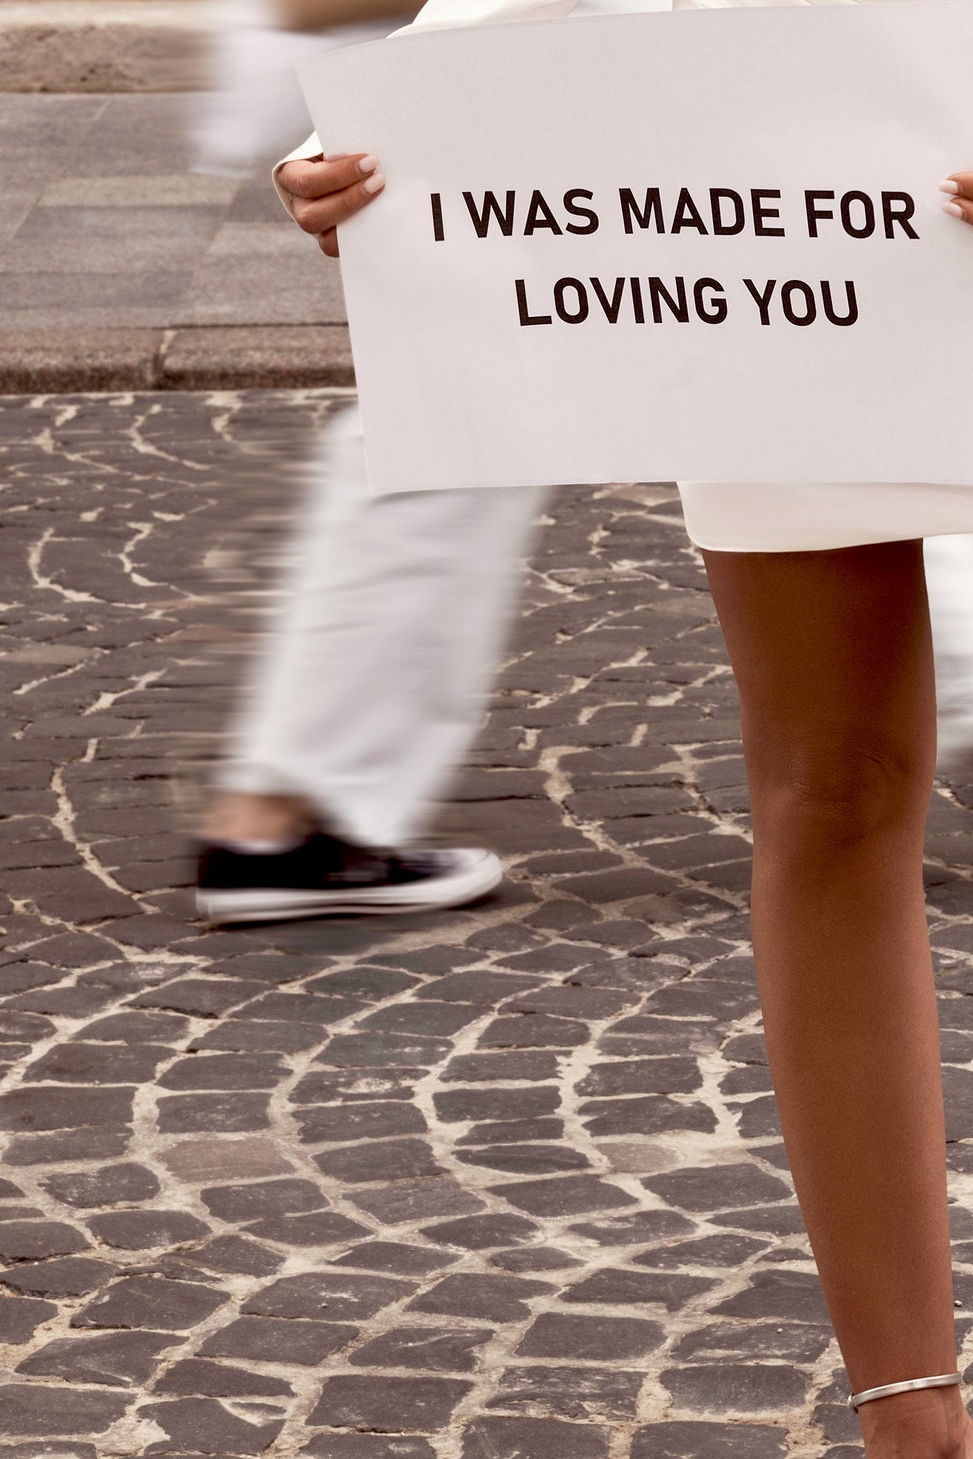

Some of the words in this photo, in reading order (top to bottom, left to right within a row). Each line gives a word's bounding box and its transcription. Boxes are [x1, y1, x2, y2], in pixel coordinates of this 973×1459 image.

[430, 192, 445, 242] I
[461, 187, 600, 239] WAS
[618, 187, 786, 238] MADE
[804, 189, 921, 240] FOR
[514, 276, 728, 327] LOVING
[742, 278, 860, 327] YOU
